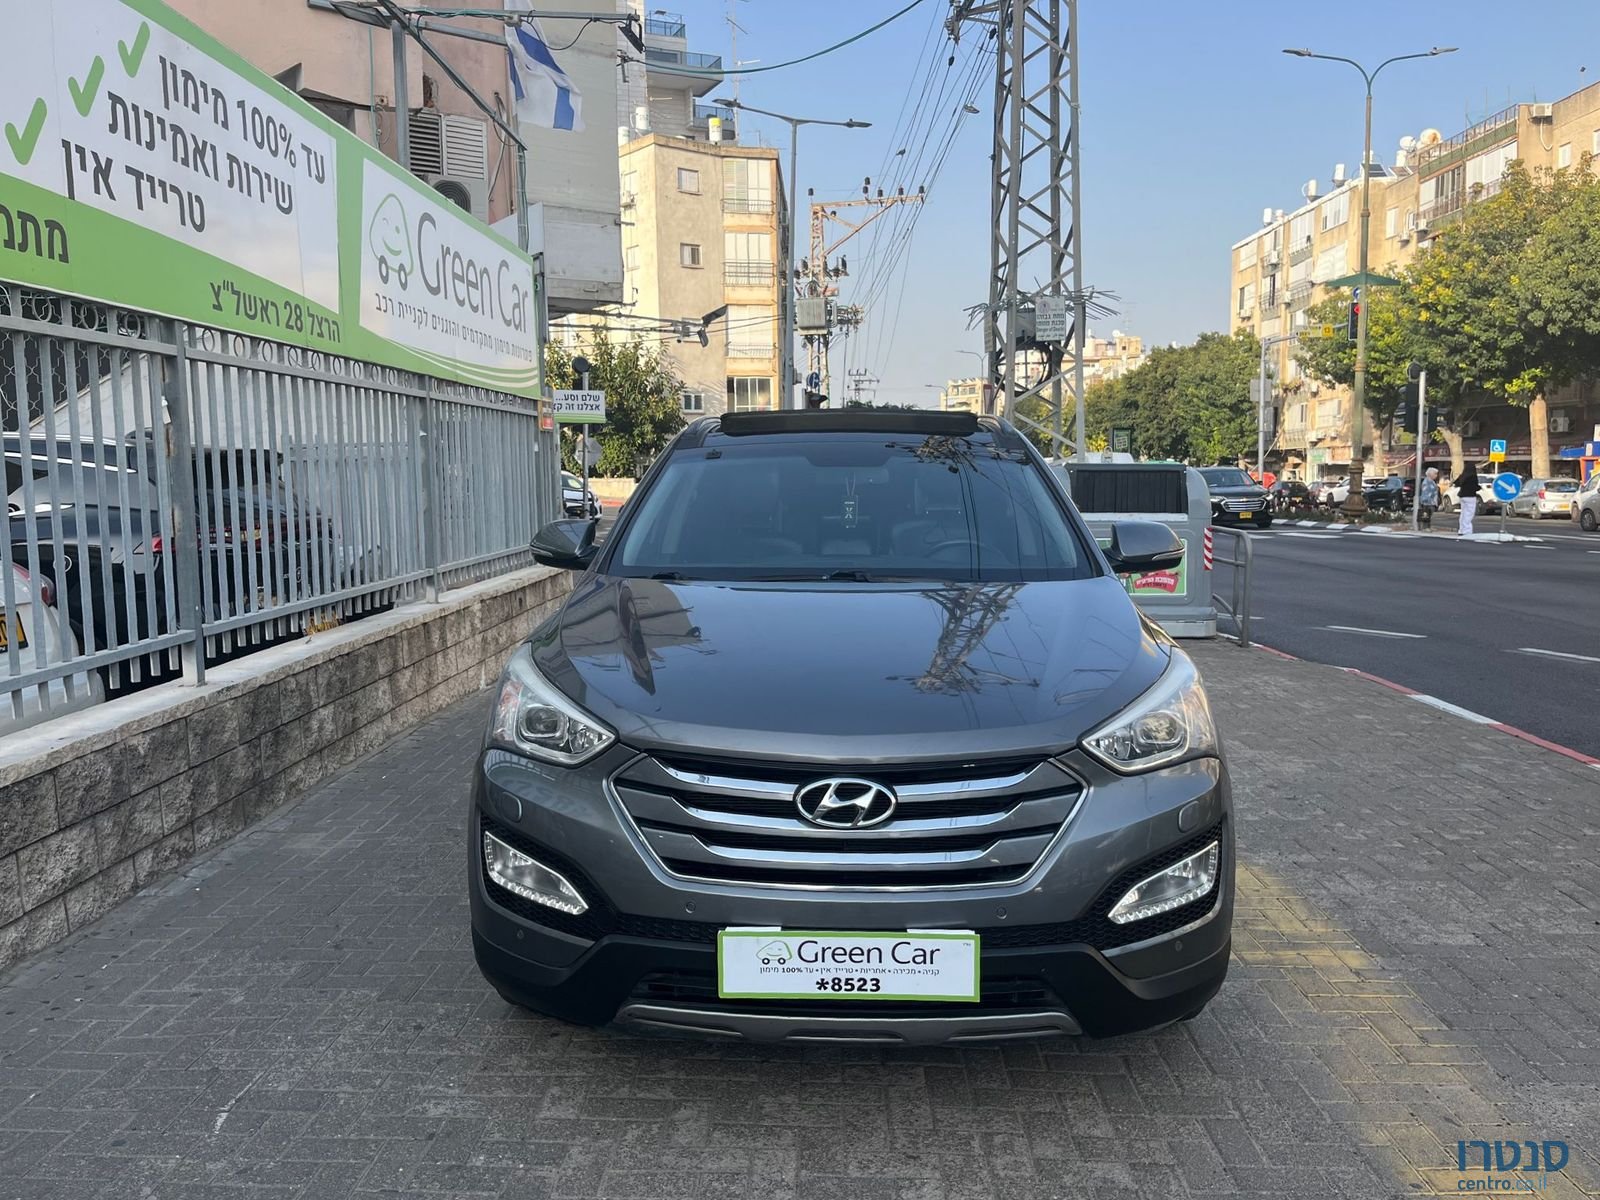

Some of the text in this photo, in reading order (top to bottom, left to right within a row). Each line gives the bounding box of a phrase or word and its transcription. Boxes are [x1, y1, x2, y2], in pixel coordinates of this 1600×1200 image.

[158, 54, 326, 185] עד 100% מימון
[107, 90, 293, 215] שירות ואמינות
[61, 138, 206, 233] טרייד אין
[417, 211, 529, 335] Green Car
[375, 292, 395, 316] רכב
[397, 301, 429, 330] לקניית
[283, 300, 304, 334] 28
[306, 305, 341, 344] הרצל
[431, 313, 460, 339] והוגנים
[461, 325, 493, 350] מתקדמים
[565, 403, 575, 411] זה
[576, 402, 601, 411] אצלנו
[581, 392, 600, 402] שלם
[796, 939, 941, 966] Green Car
[759, 966, 780, 975] מימון
[781, 966, 803, 974] 100%
[804, 966, 814, 974] עד
[820, 966, 832, 975] אין
[859, 967, 887, 975] אחריות
[892, 967, 917, 975] מכירה
[922, 967, 940, 977] קניה
